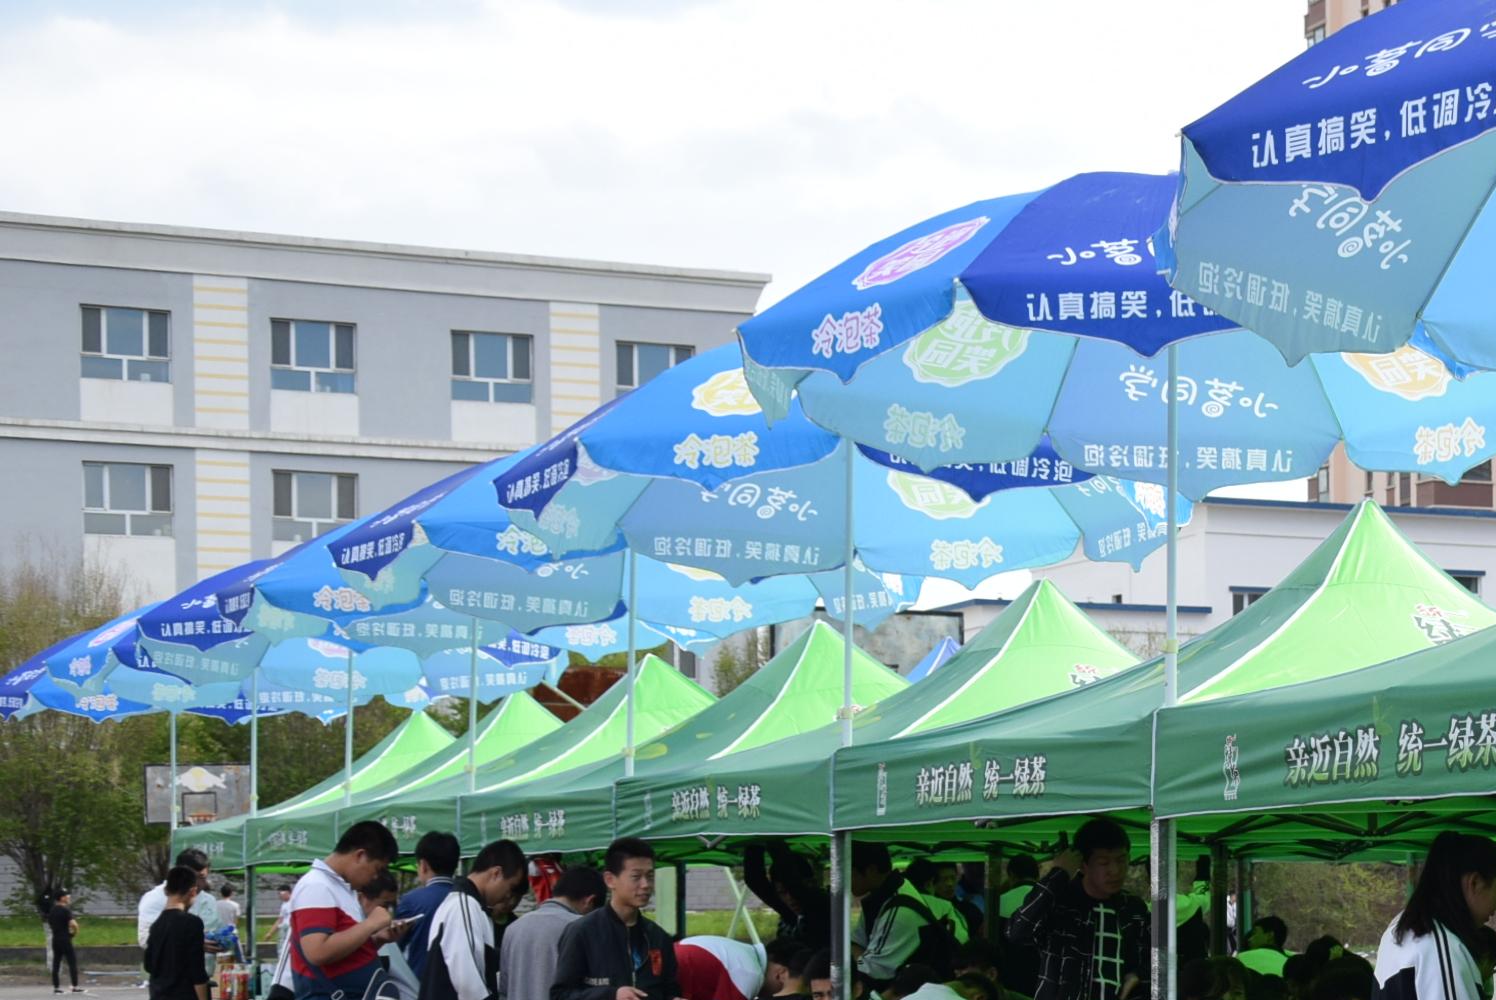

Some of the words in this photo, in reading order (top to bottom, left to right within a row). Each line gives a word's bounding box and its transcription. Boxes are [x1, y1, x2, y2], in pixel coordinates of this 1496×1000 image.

[1047, 237, 1156, 267] 小茗
[1026, 290, 1216, 322] 认真搞笑，低
[812, 302, 885, 359] 冷泡茶
[673, 430, 760, 470] 冷泡茶
[496, 523, 550, 557] 冷泡
[1286, 728, 1380, 786] 亲近自然
[916, 764, 974, 807] 亲近自然
[984, 756, 1047, 799] 统一绿茶
